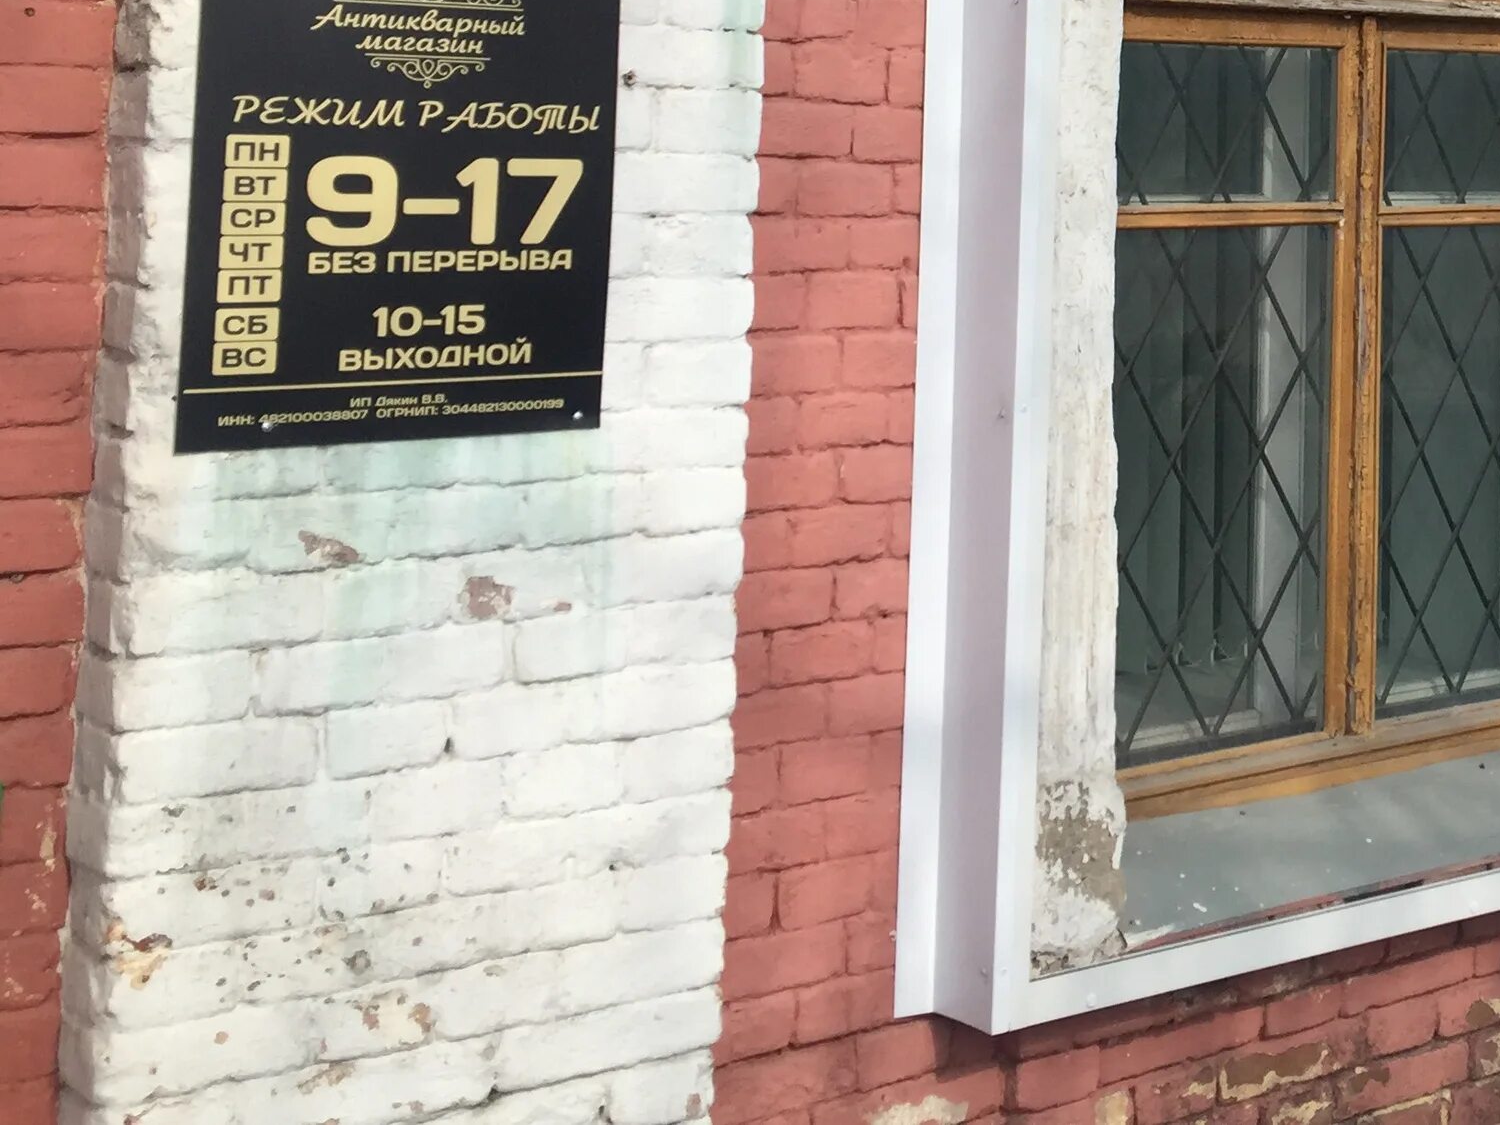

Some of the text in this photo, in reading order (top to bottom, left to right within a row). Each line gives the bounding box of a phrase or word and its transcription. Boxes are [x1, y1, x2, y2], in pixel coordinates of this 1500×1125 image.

[310, 3, 527, 37] Антикварный
[355, 33, 485, 54] магазин
[232, 94, 405, 129] РЕЖИМ
[233, 141, 281, 163] ПН
[233, 175, 277, 196] ВТ
[305, 155, 584, 247] 9-17
[229, 208, 277, 230] СР
[229, 242, 272, 263] ЧТ
[307, 249, 573, 275] БЕЗ ПЕРЕРЫВА
[228, 275, 273, 296] ПТ
[222, 315, 268, 335] СБ
[372, 303, 487, 338] 10-15
[221, 347, 267, 368] ВС
[338, 336, 532, 372] ВЫХОДНОЙ
[350, 397, 371, 408] ИП
[217, 414, 256, 427] ИНН:
[375, 406, 439, 419] ОГРНИП:
